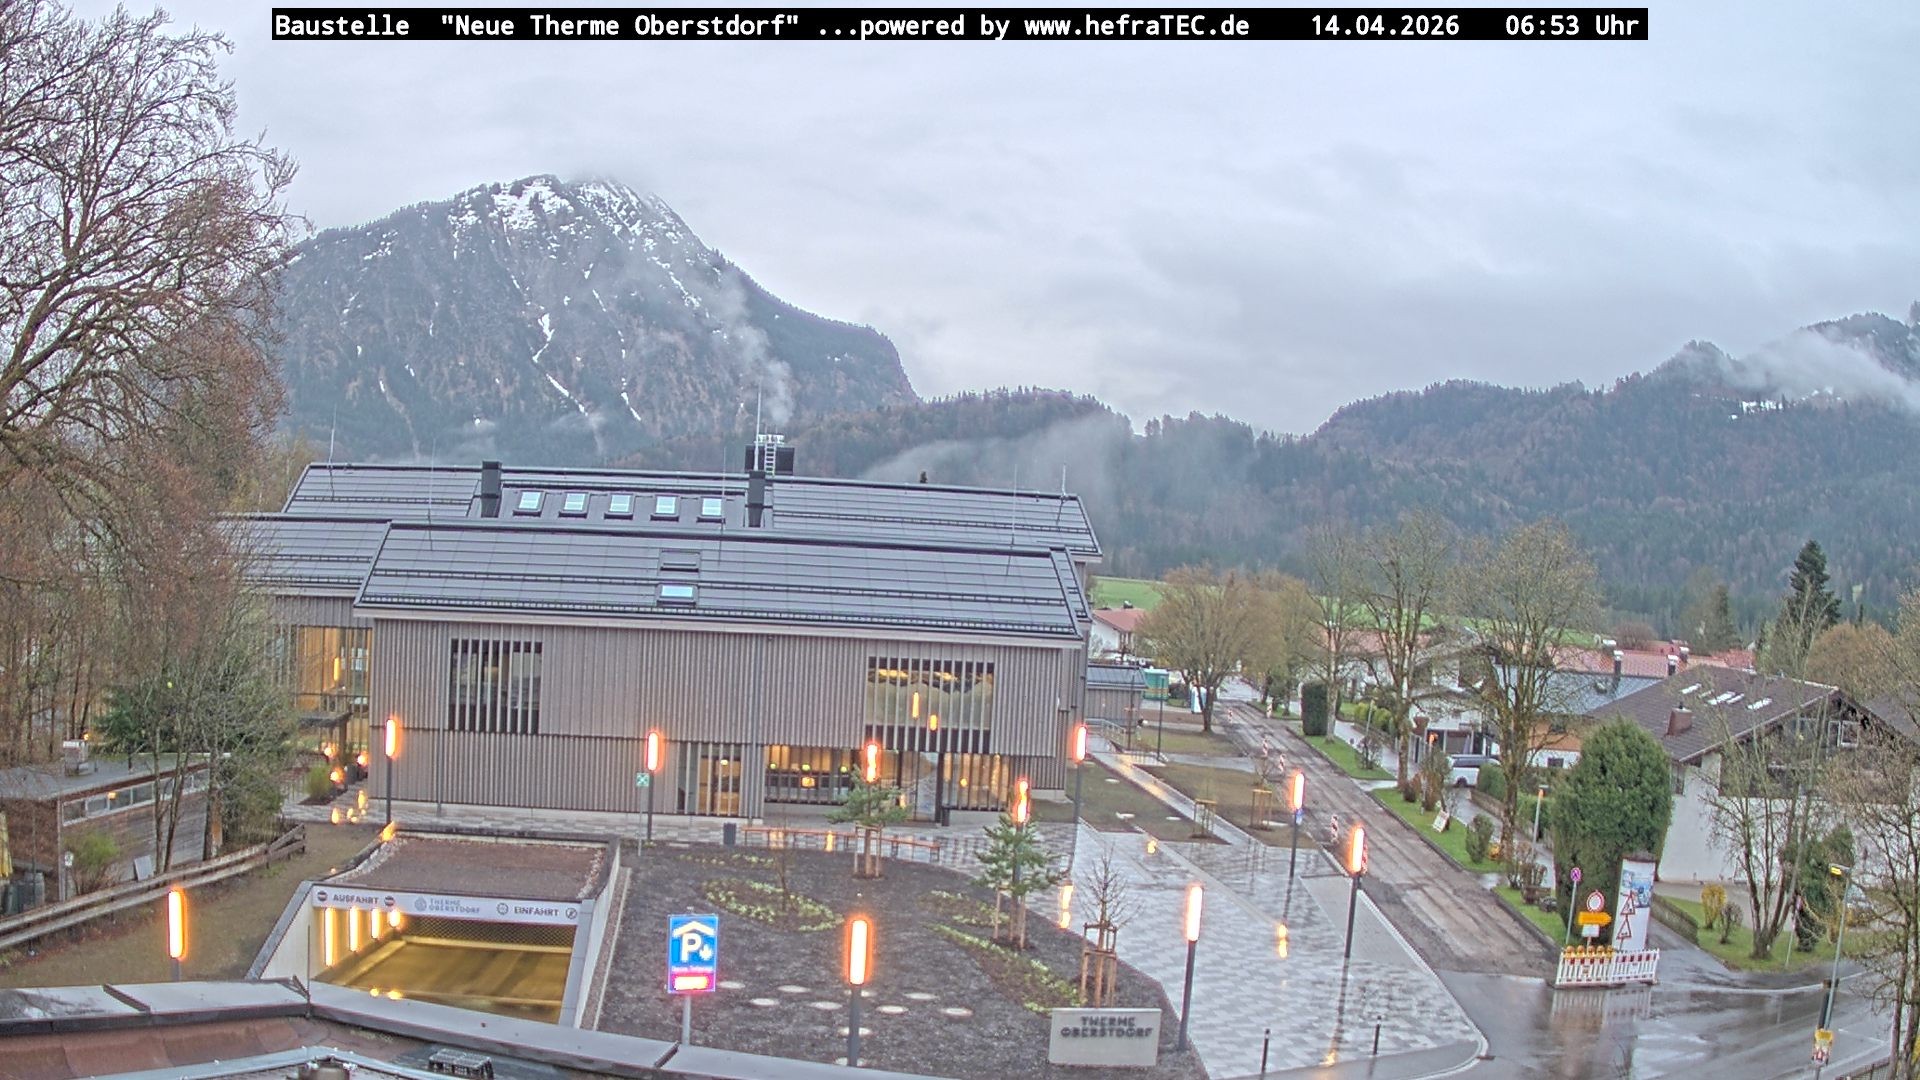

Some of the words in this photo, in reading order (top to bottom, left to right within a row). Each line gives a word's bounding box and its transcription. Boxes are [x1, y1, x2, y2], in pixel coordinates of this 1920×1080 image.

[333, 894, 379, 905] AUSFAHRT
[513, 906, 560, 917] EINFAHRT
[680, 932, 702, 962] P
[1081, 1016, 1136, 1027] THERME
[1060, 1026, 1154, 1038] OBERSTDORF
